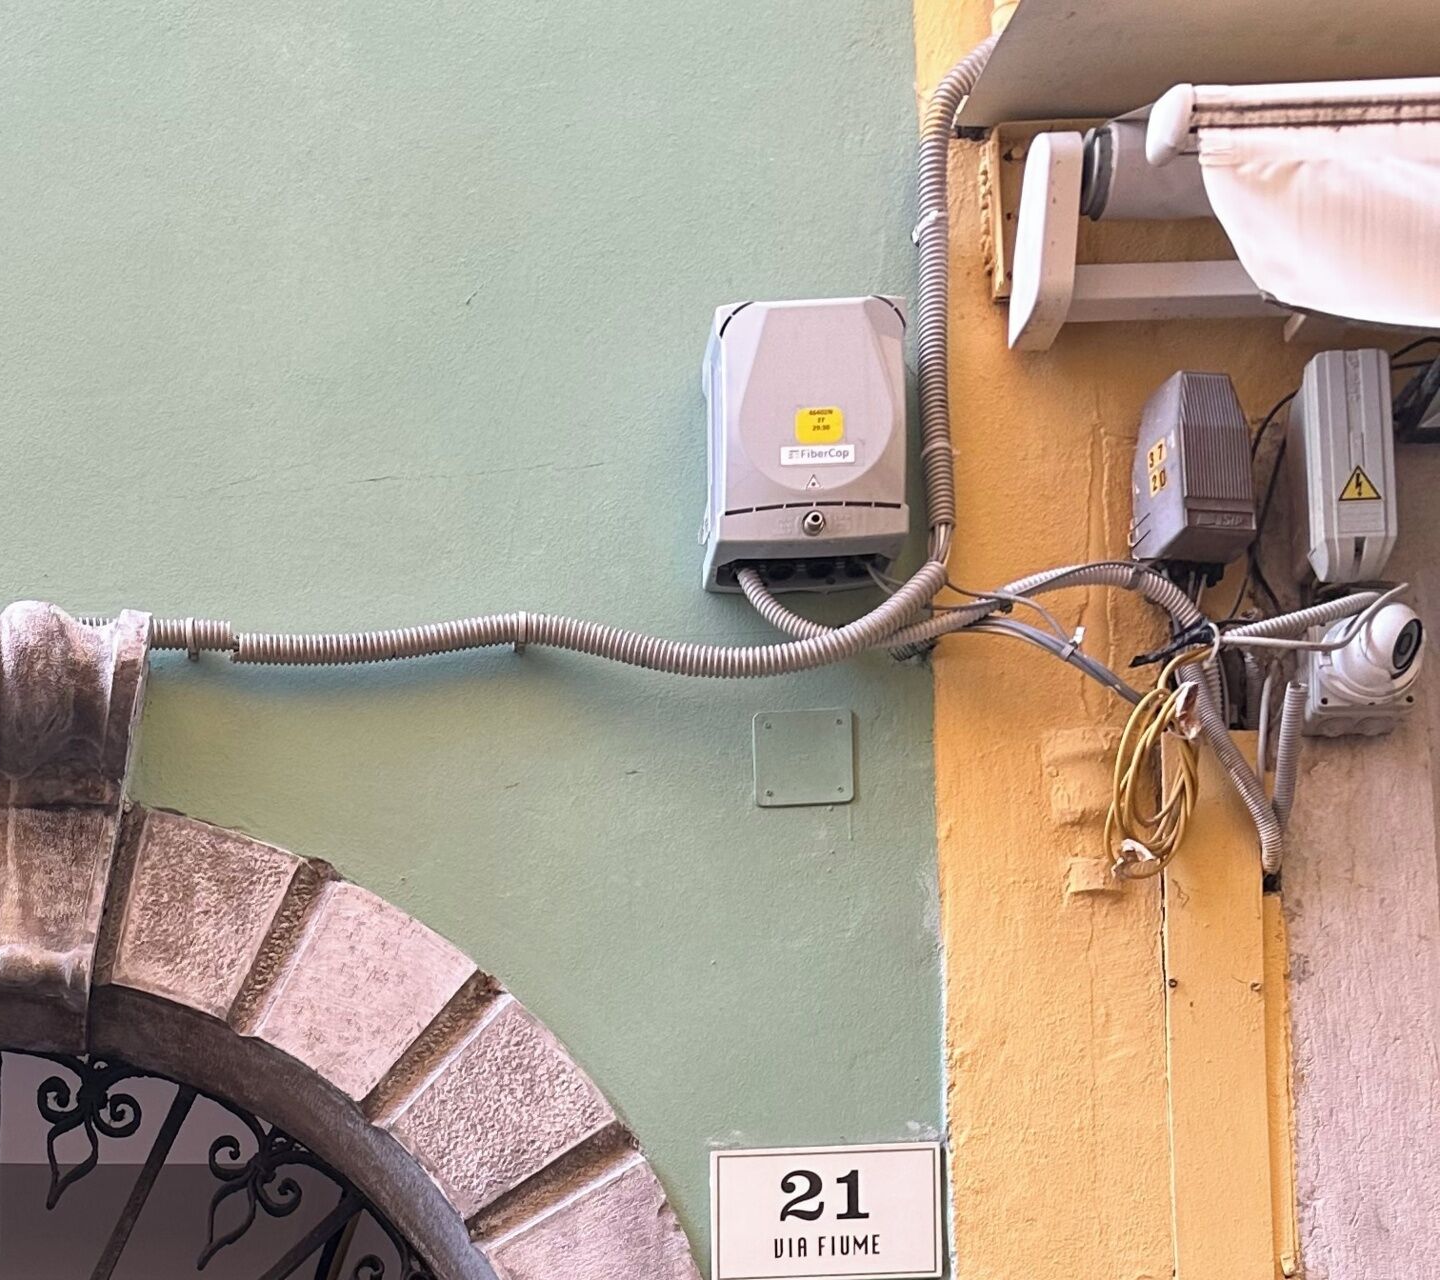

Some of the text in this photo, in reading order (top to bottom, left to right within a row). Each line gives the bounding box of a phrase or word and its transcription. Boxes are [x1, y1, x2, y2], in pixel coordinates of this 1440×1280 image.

[800, 448, 850, 460] FiberCop
[779, 1169, 870, 1222] 21
[774, 1233, 881, 1259] VIA FIUME
